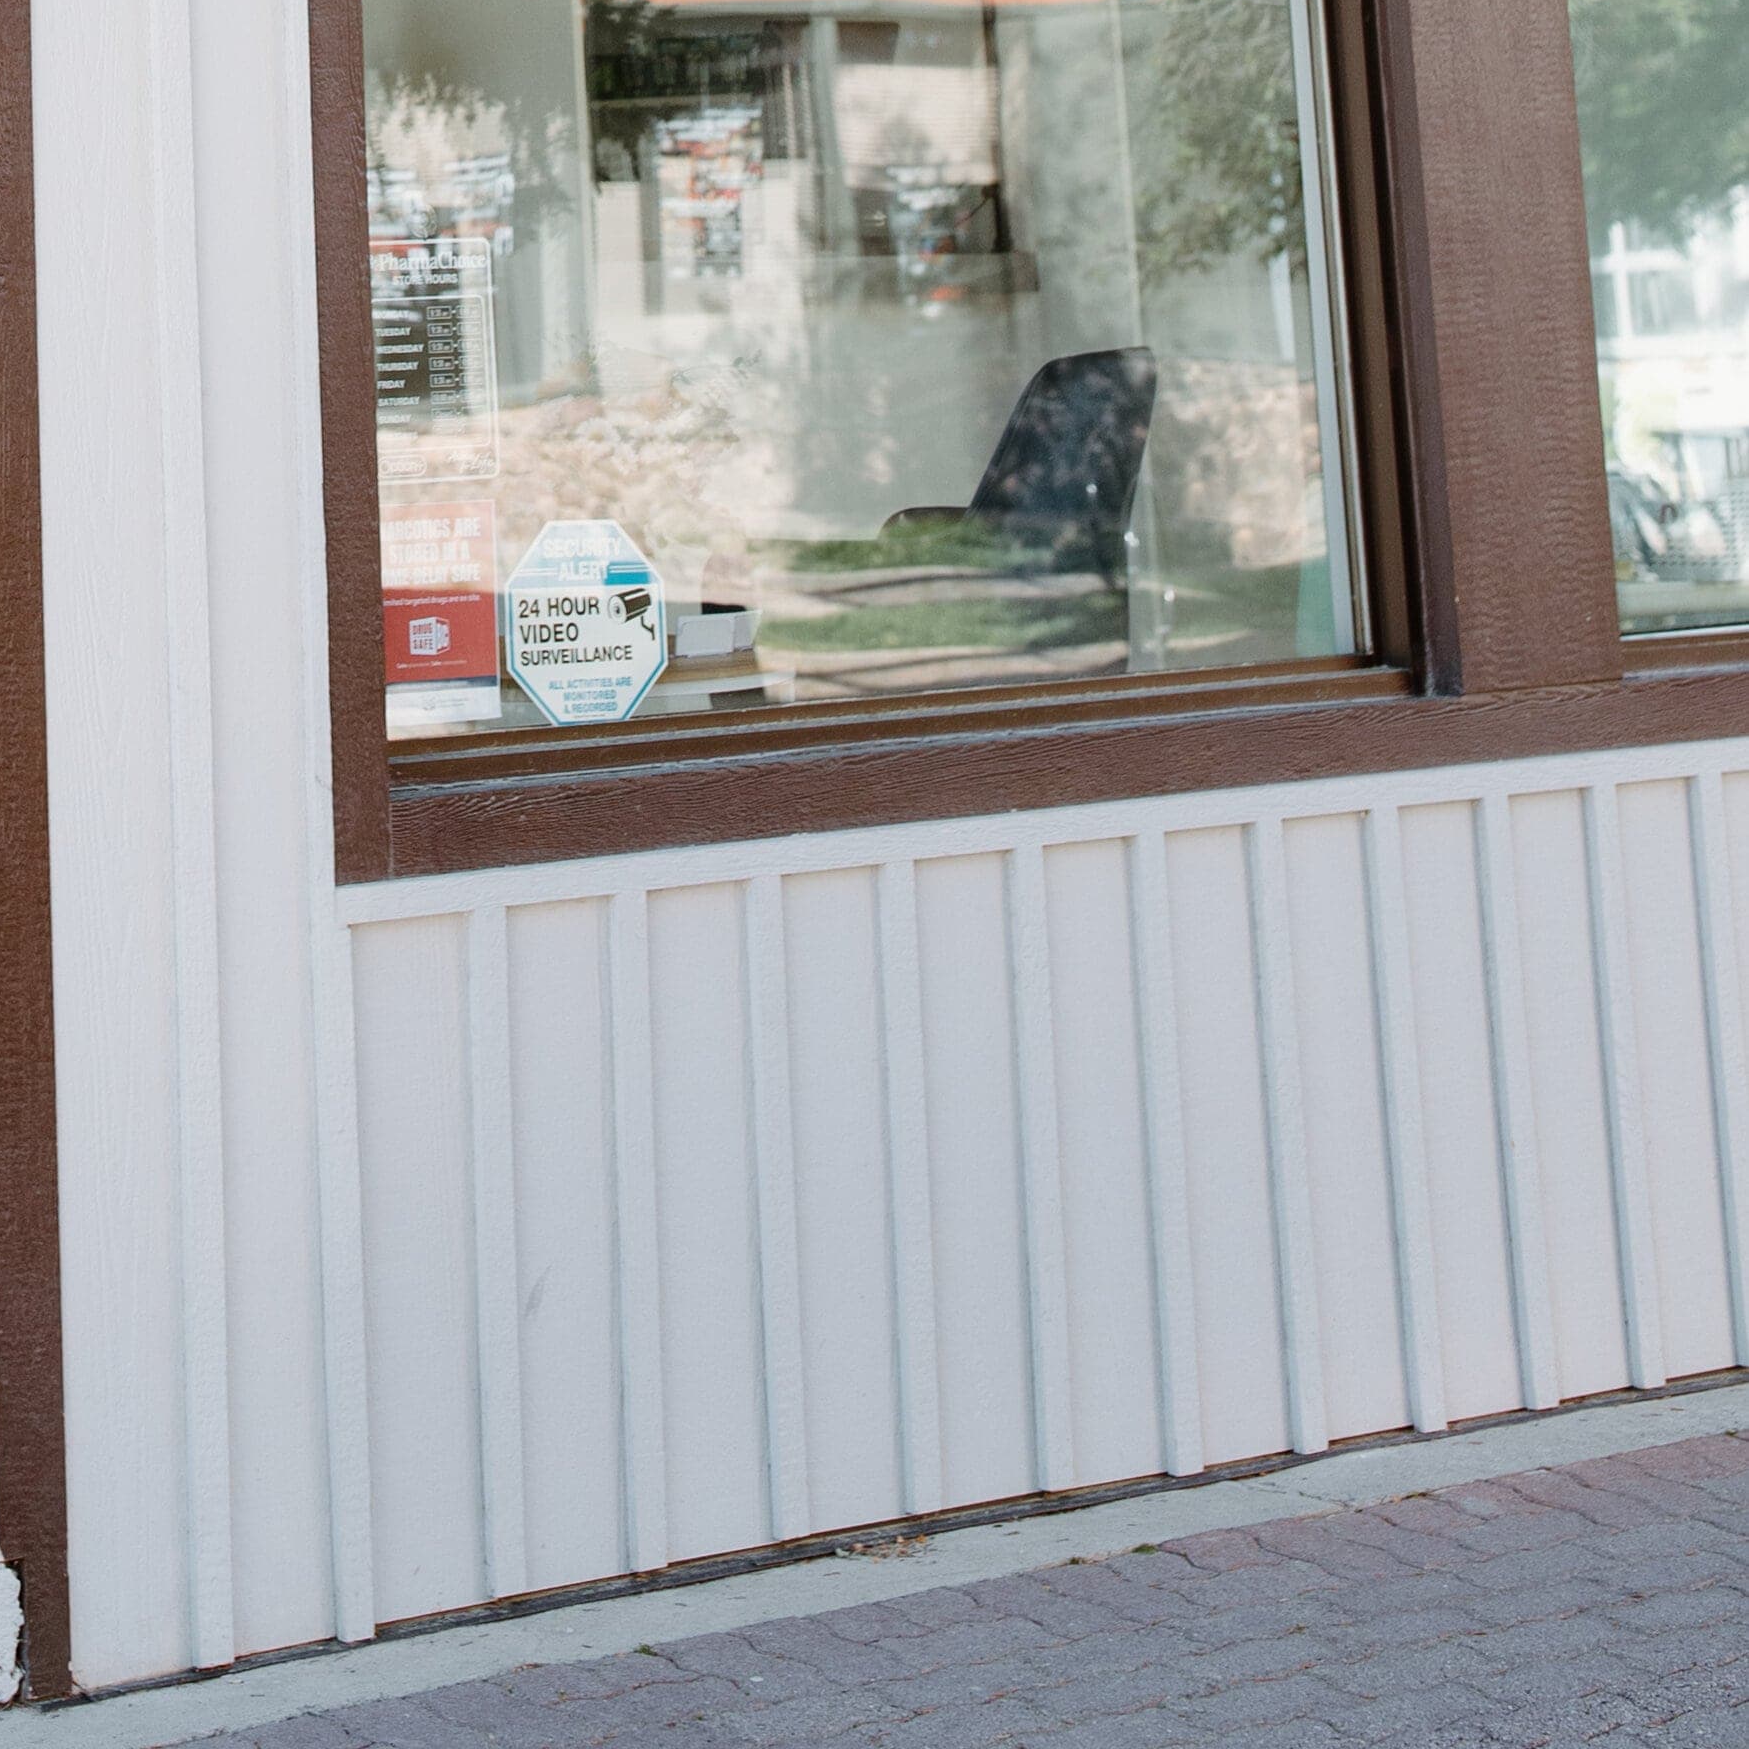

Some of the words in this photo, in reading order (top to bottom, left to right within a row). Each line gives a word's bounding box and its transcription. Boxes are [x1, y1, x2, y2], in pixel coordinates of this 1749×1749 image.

[392, 275, 424, 286] STORE
[425, 273, 458, 285] HOURS
[454, 516, 481, 537] ARE
[544, 537, 622, 558] SECURITY
[558, 560, 610, 581] ALERT
[519, 599, 540, 619] 24
[547, 596, 600, 617] HOUR
[519, 622, 579, 644] VIDEO
[412, 638, 434, 651] SAFE
[520, 645, 633, 666] SURVEILLANCE
[548, 679, 564, 690] ALL
[567, 677, 613, 689] ACTIVITIES
[615, 675, 633, 687] ARE
[563, 689, 617, 702] MONITORED
[571, 701, 618, 713] RECORDED
